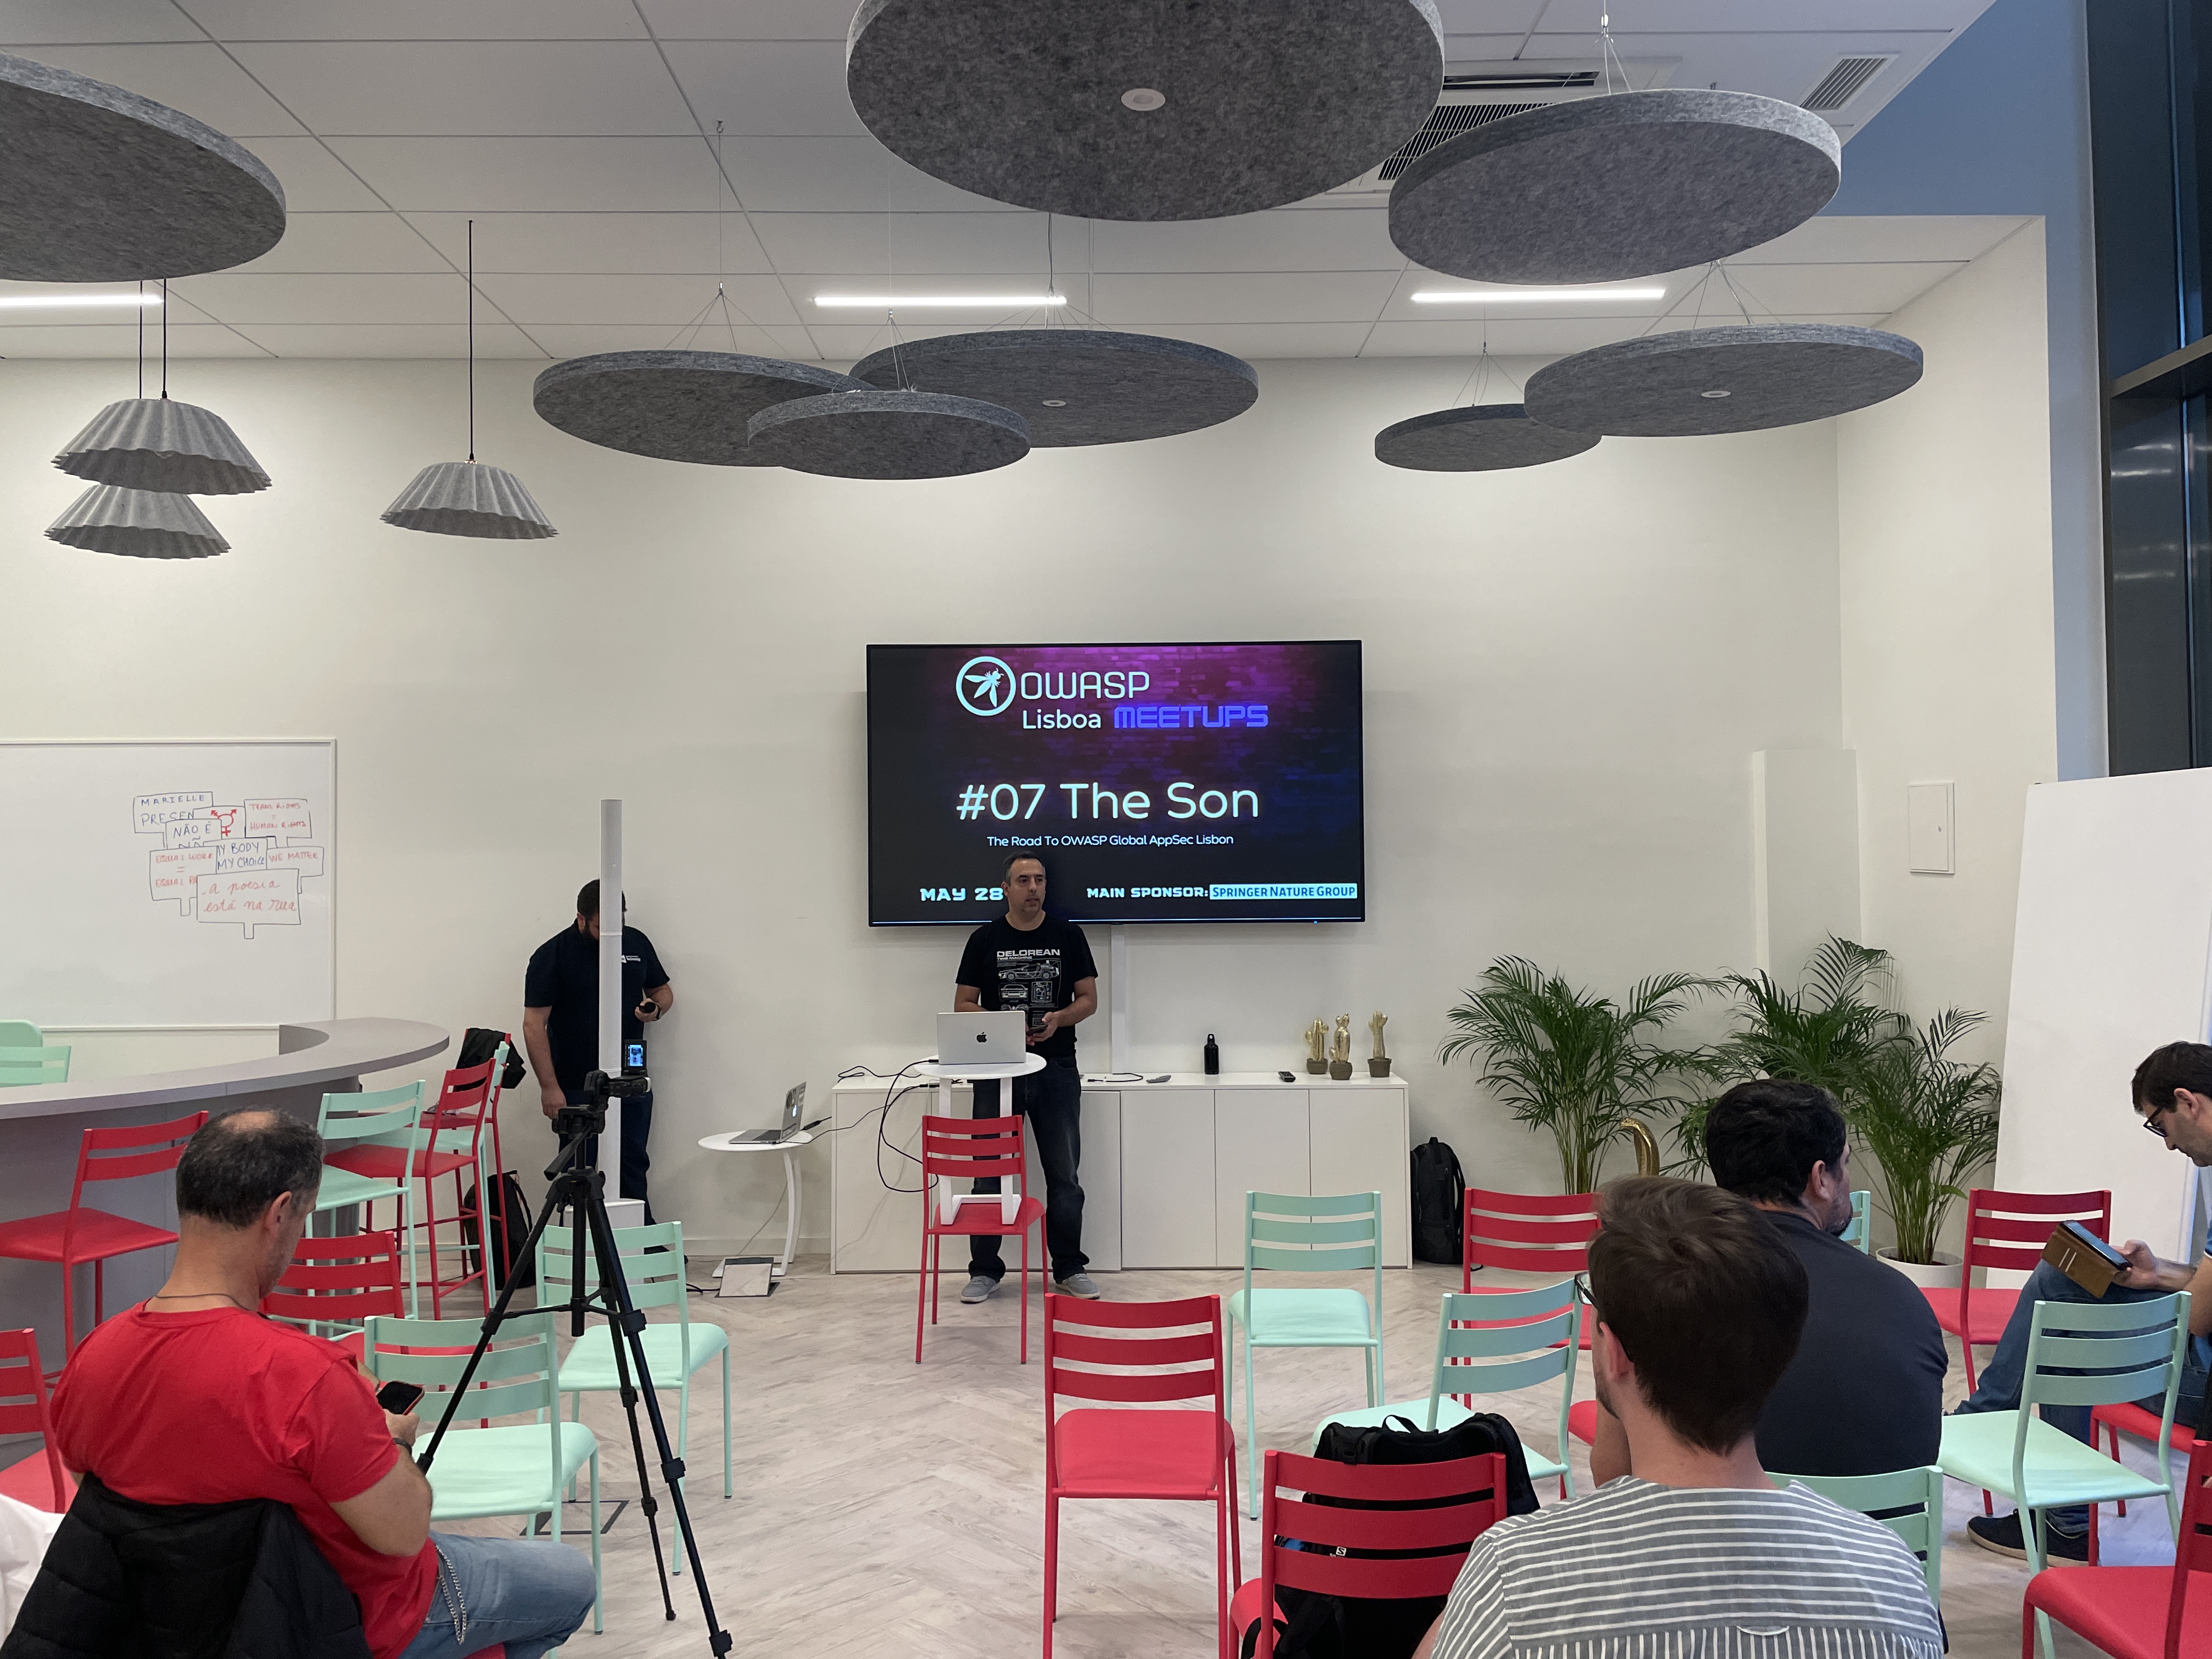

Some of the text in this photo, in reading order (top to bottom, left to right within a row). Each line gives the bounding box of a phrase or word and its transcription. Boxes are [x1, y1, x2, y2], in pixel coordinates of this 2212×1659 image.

[1020, 672, 1150, 699] OWASP
[1023, 705, 1269, 729] Lisboa MEETUPS
[141, 795, 204, 806] MARIELLE
[956, 782, 1259, 821] #07 The Son
[173, 821, 211, 839] NÃO É
[250, 821, 278, 831] HUMAN
[987, 834, 1234, 848] The Road To OWASP Global AppSec Lisbon
[231, 842, 259, 854] BODY
[155, 854, 185, 863] EQUAL
[268, 851, 318, 862] WE MATTER
[217, 857, 234, 870] MY
[155, 878, 184, 888] EQUAL
[228, 880, 280, 895] poesia
[920, 888, 1003, 901] MAY 28
[1087, 887, 1209, 898] MAIN SPONSOR:
[1212, 886, 1356, 897] SPRINGER NATURE GROUP
[203, 899, 297, 912] está na rua
[997, 949, 1060, 957] DELOREAN
